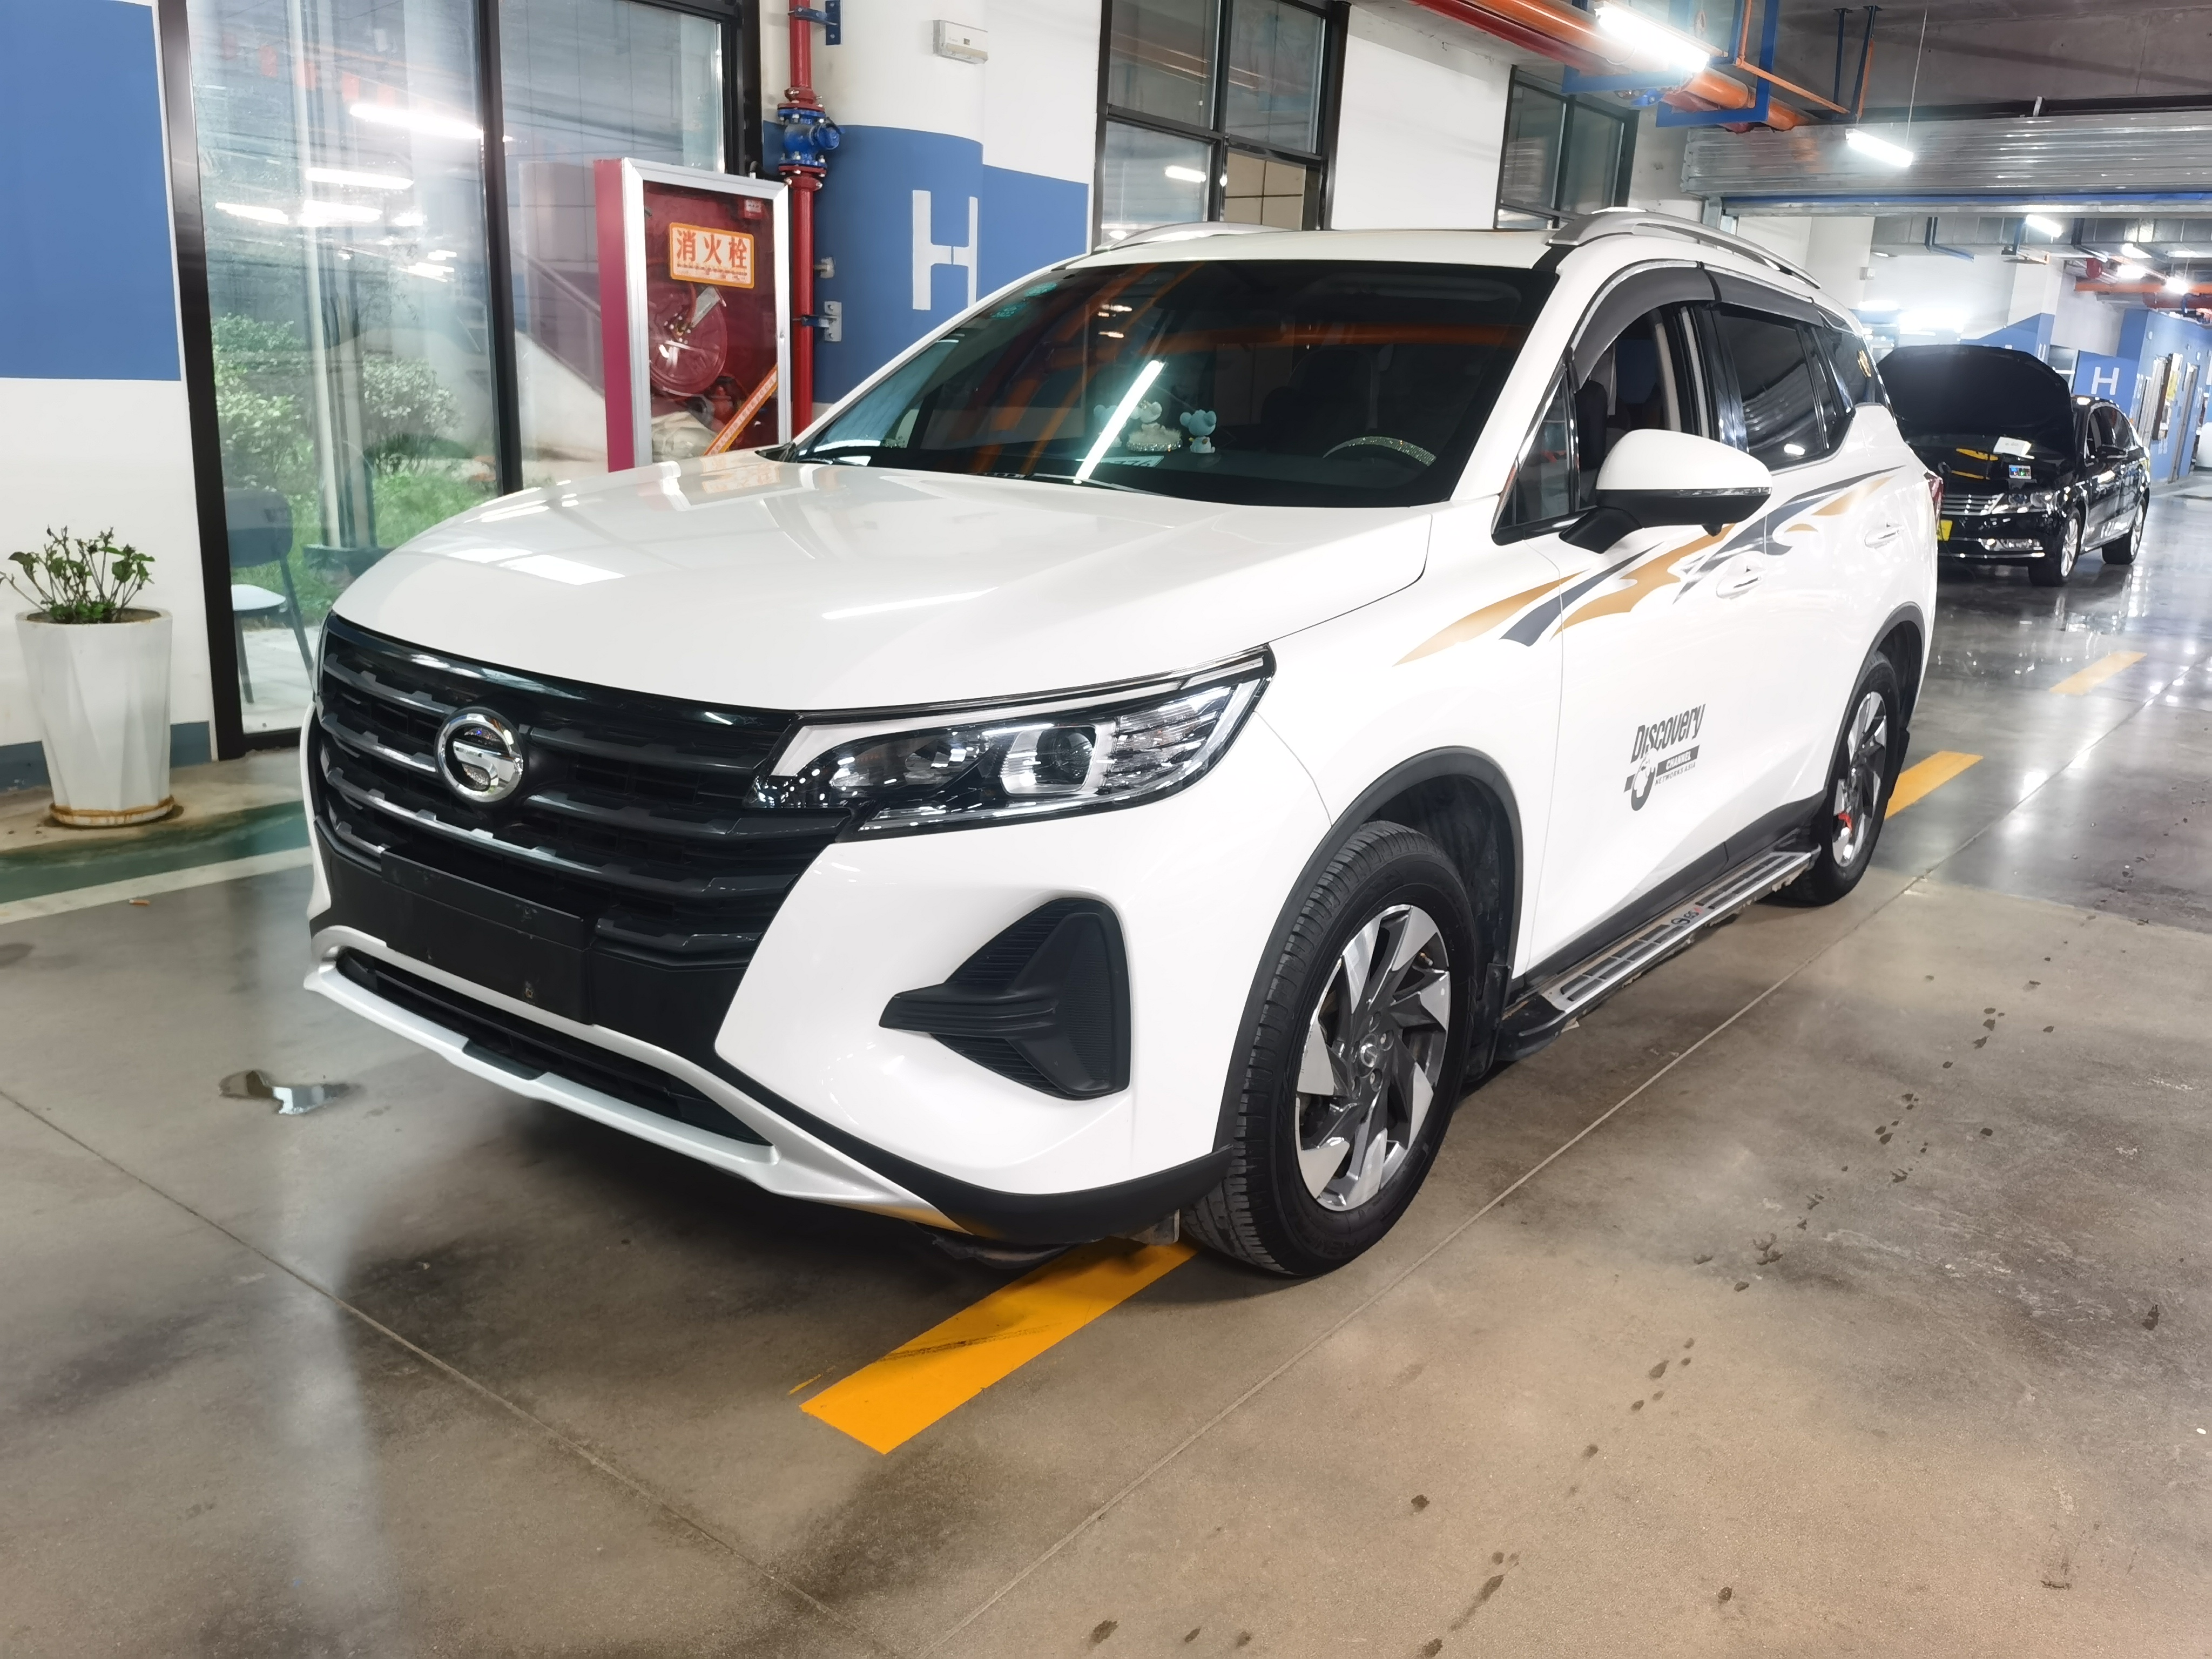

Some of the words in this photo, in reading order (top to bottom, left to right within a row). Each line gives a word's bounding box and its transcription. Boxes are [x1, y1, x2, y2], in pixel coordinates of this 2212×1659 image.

[677, 230, 747, 269] 消火栓
[913, 190, 978, 311] H
[2091, 367, 2120, 395] H
[1666, 751, 1691, 771] CHANNEL
